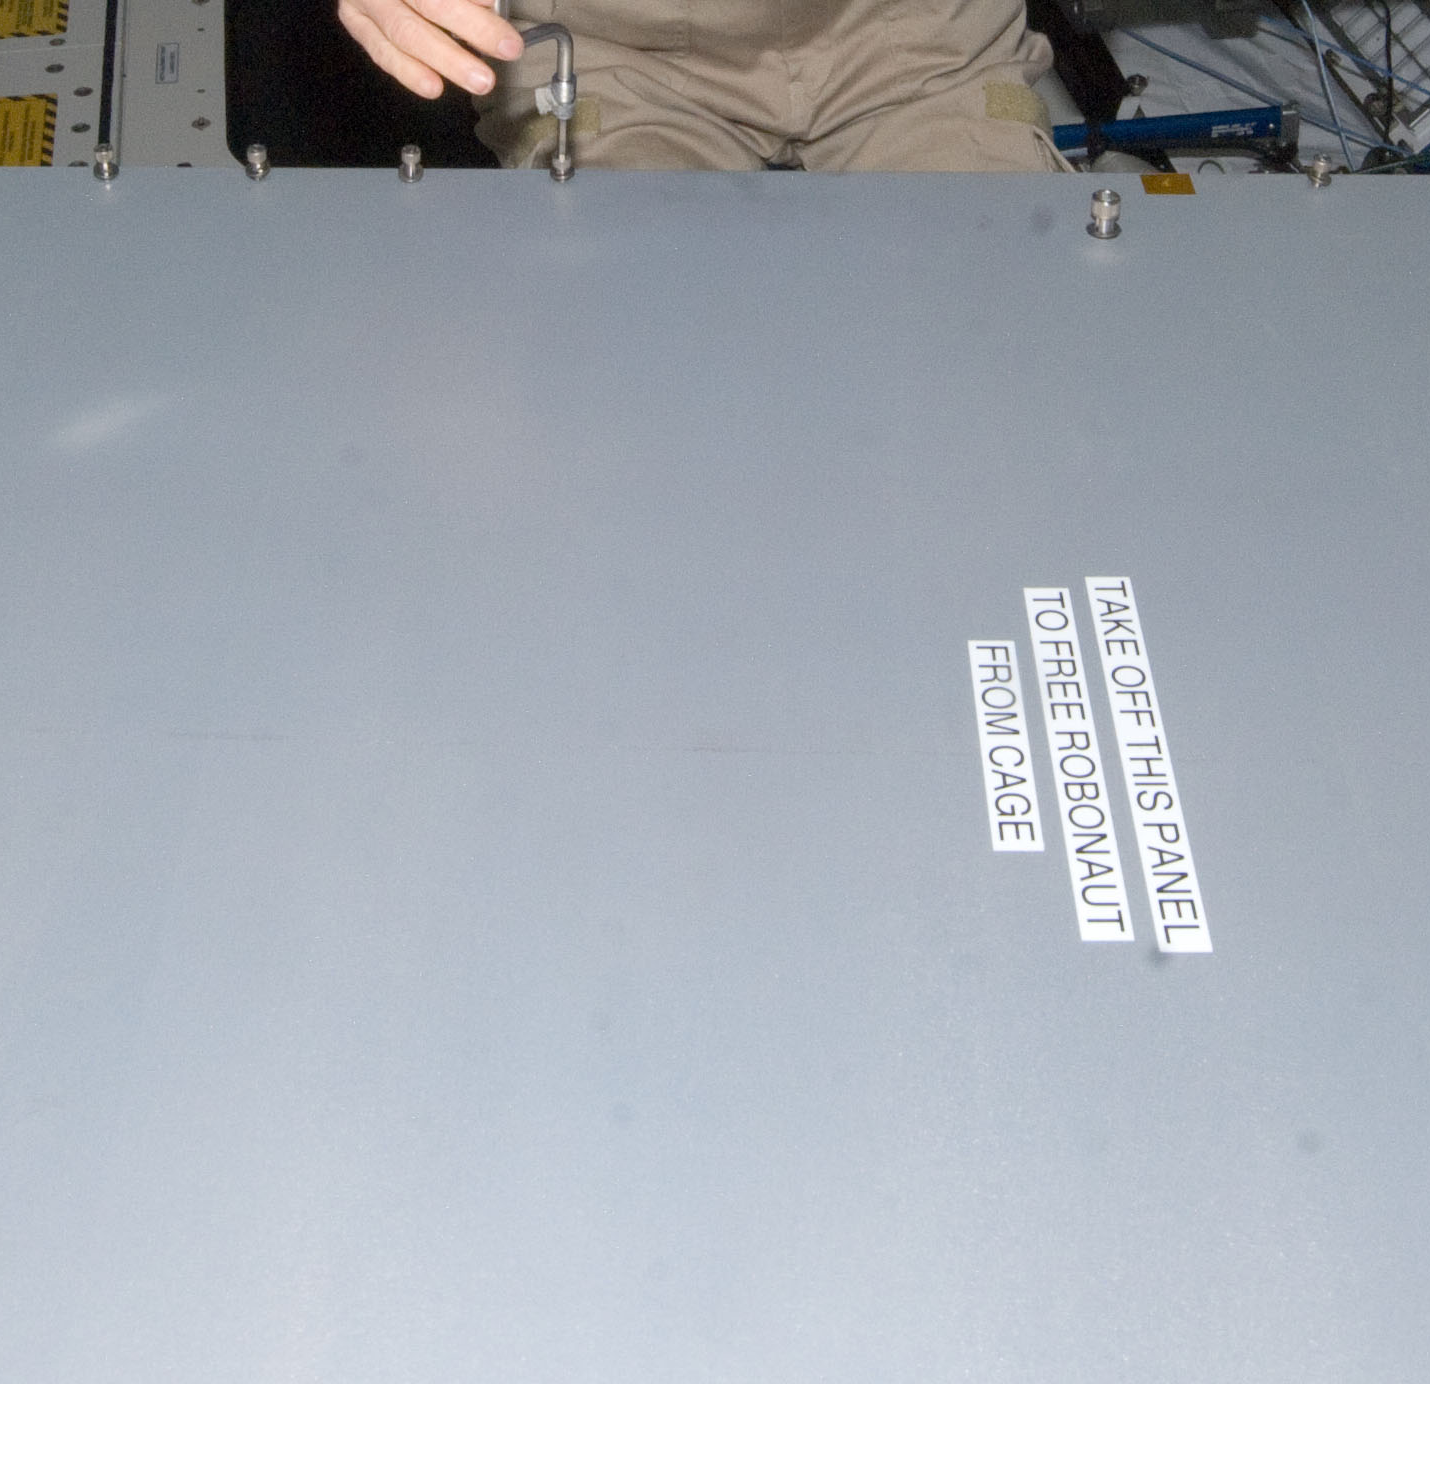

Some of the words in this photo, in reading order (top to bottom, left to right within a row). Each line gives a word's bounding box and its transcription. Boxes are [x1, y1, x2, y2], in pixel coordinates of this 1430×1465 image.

[1031, 591, 1068, 631] TO
[1093, 579, 1140, 656] TAKE
[975, 644, 1019, 736] FROM
[1039, 640, 1086, 721] FREE
[1112, 665, 1157, 729] OFF
[988, 748, 1036, 843] CAGE
[1125, 735, 1171, 811] THIS
[1055, 730, 1127, 934] ROBONAUT
[1143, 822, 1201, 944] PANEL
